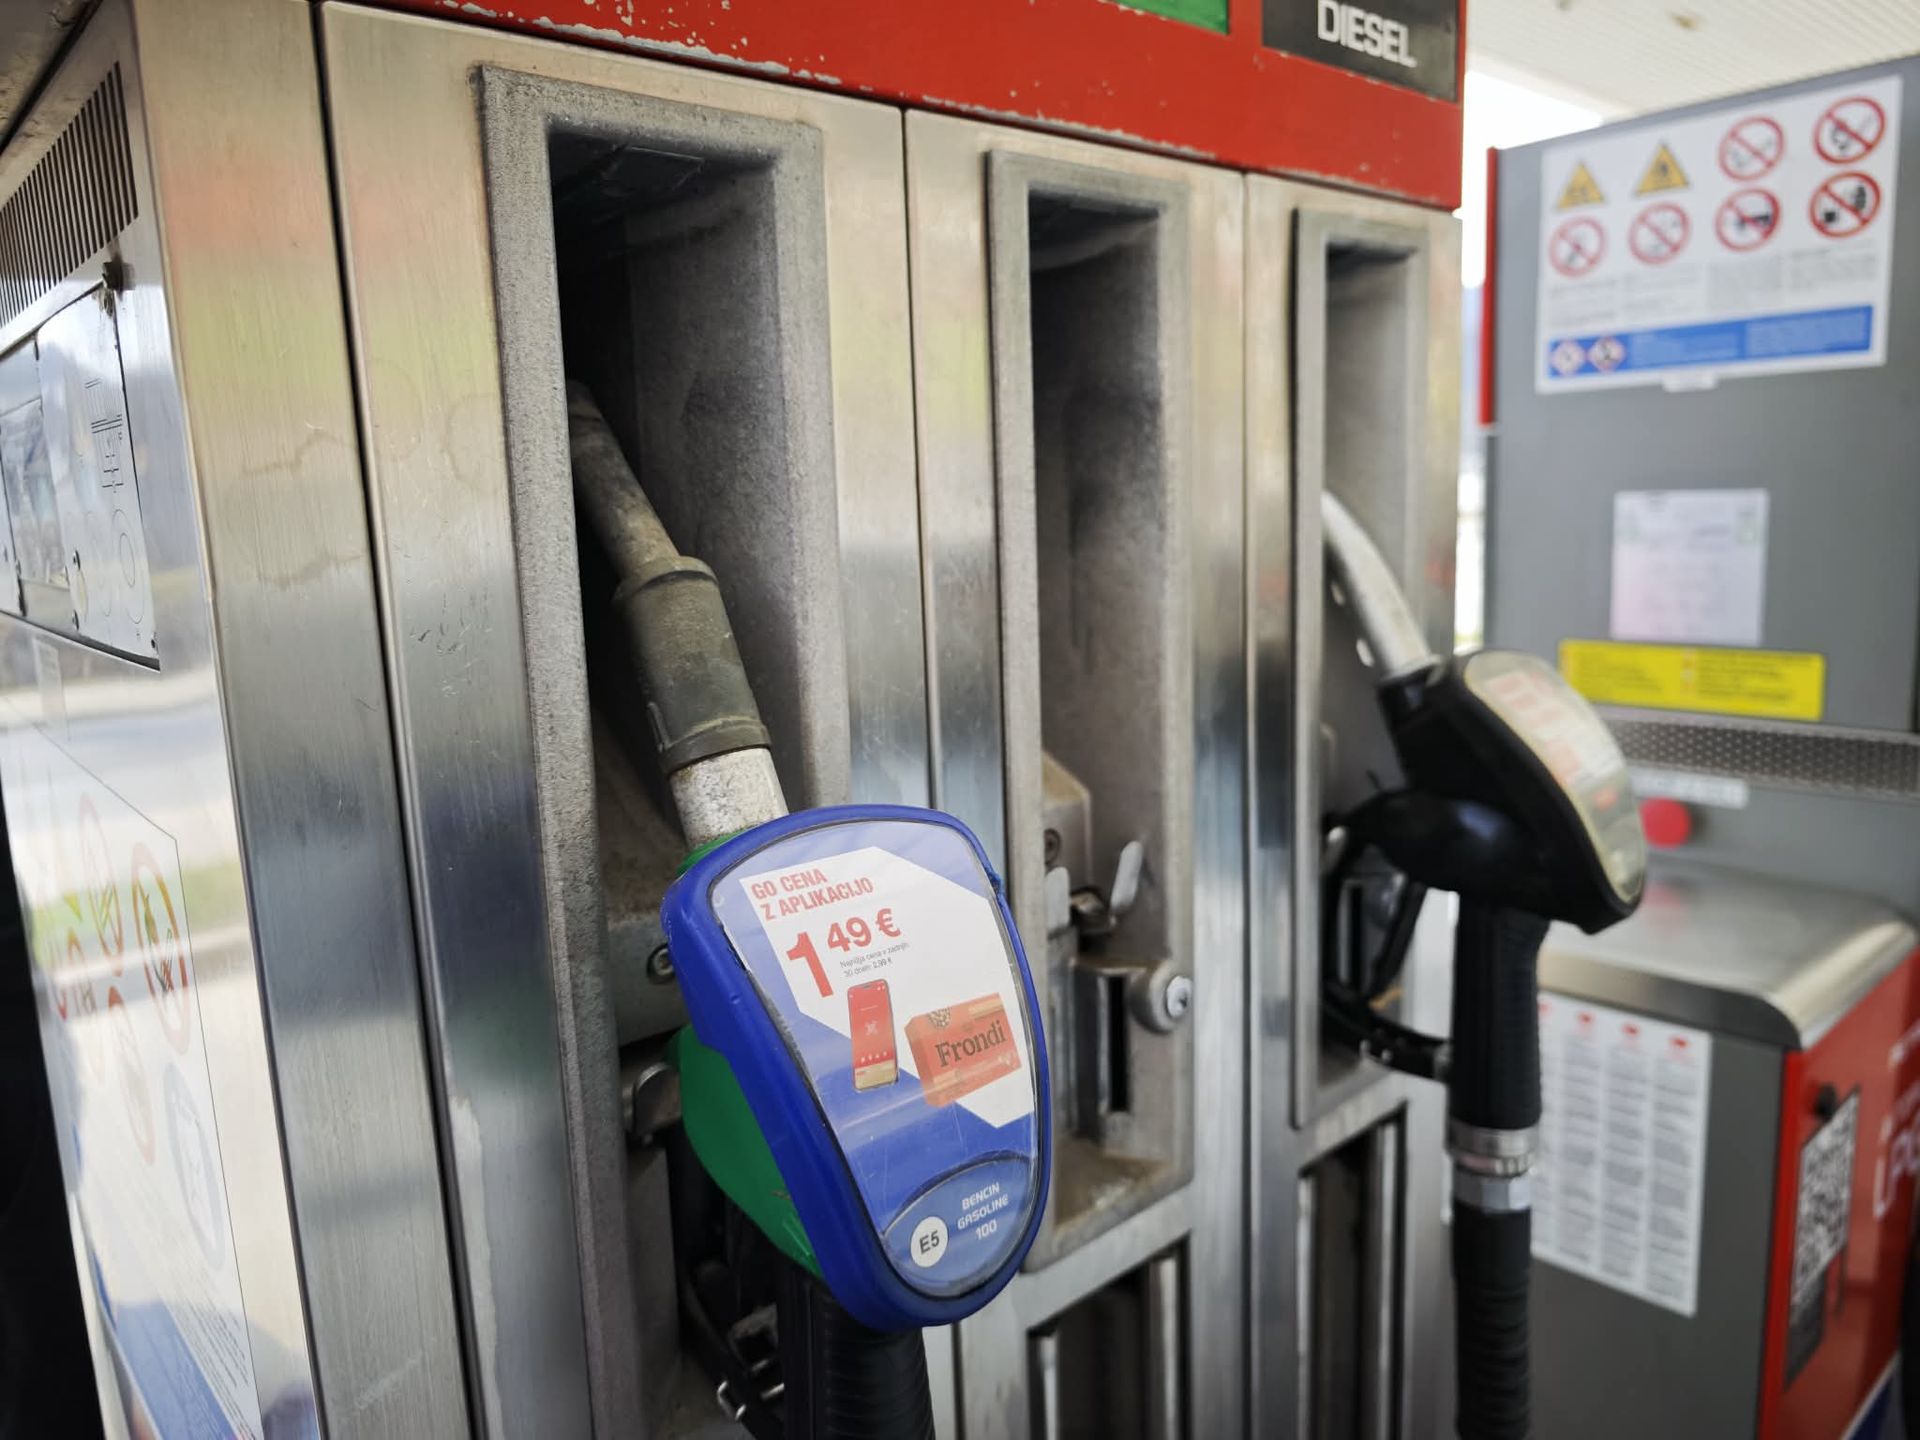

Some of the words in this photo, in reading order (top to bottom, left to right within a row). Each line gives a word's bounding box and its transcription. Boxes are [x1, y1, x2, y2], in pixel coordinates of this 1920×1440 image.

[1317, 0, 1418, 69] DIESEL
[751, 879, 778, 900] GO
[780, 868, 828, 893] CENA
[760, 902, 776, 921] Z
[778, 877, 874, 917] APLIKACIJO
[786, 931, 834, 998] 1
[827, 916, 872, 952] 49
[875, 908, 901, 938] €
[934, 1019, 1007, 1068] Frondi
[957, 1194, 1009, 1230] GASOLINE
[962, 1182, 1000, 1210] BENCIN
[919, 1229, 940, 1255] E5
[976, 1219, 997, 1240] 100
